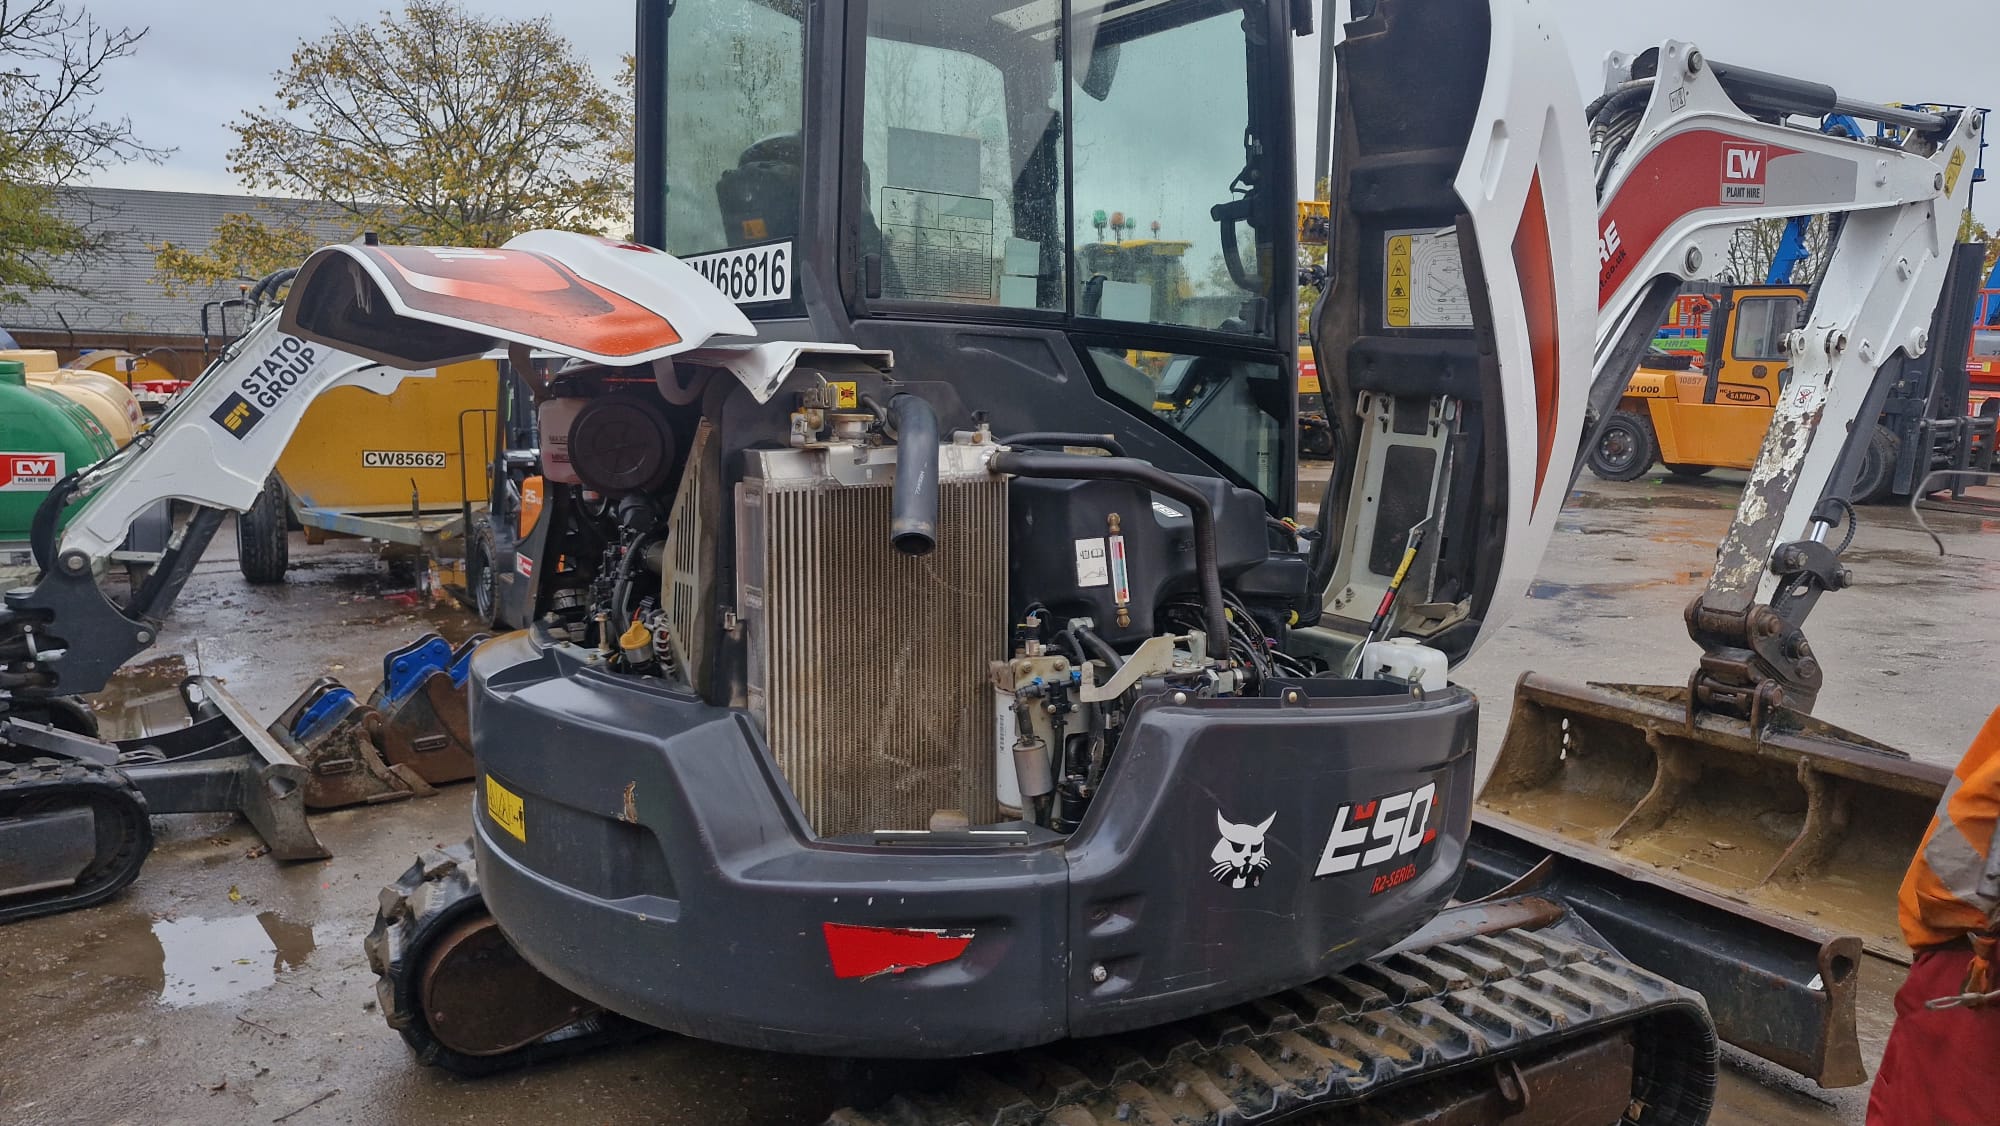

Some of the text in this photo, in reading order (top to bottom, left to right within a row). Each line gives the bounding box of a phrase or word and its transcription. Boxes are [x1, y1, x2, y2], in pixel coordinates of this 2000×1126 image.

[1726, 148, 1761, 179] CW
[1726, 186, 1761, 198] PLANT HIRE
[684, 248, 786, 300] W66816
[257, 347, 315, 409] GROUP
[16, 460, 50, 475] CW
[364, 452, 445, 467] CW85662
[1371, 863, 1417, 895] R2-SERIES
